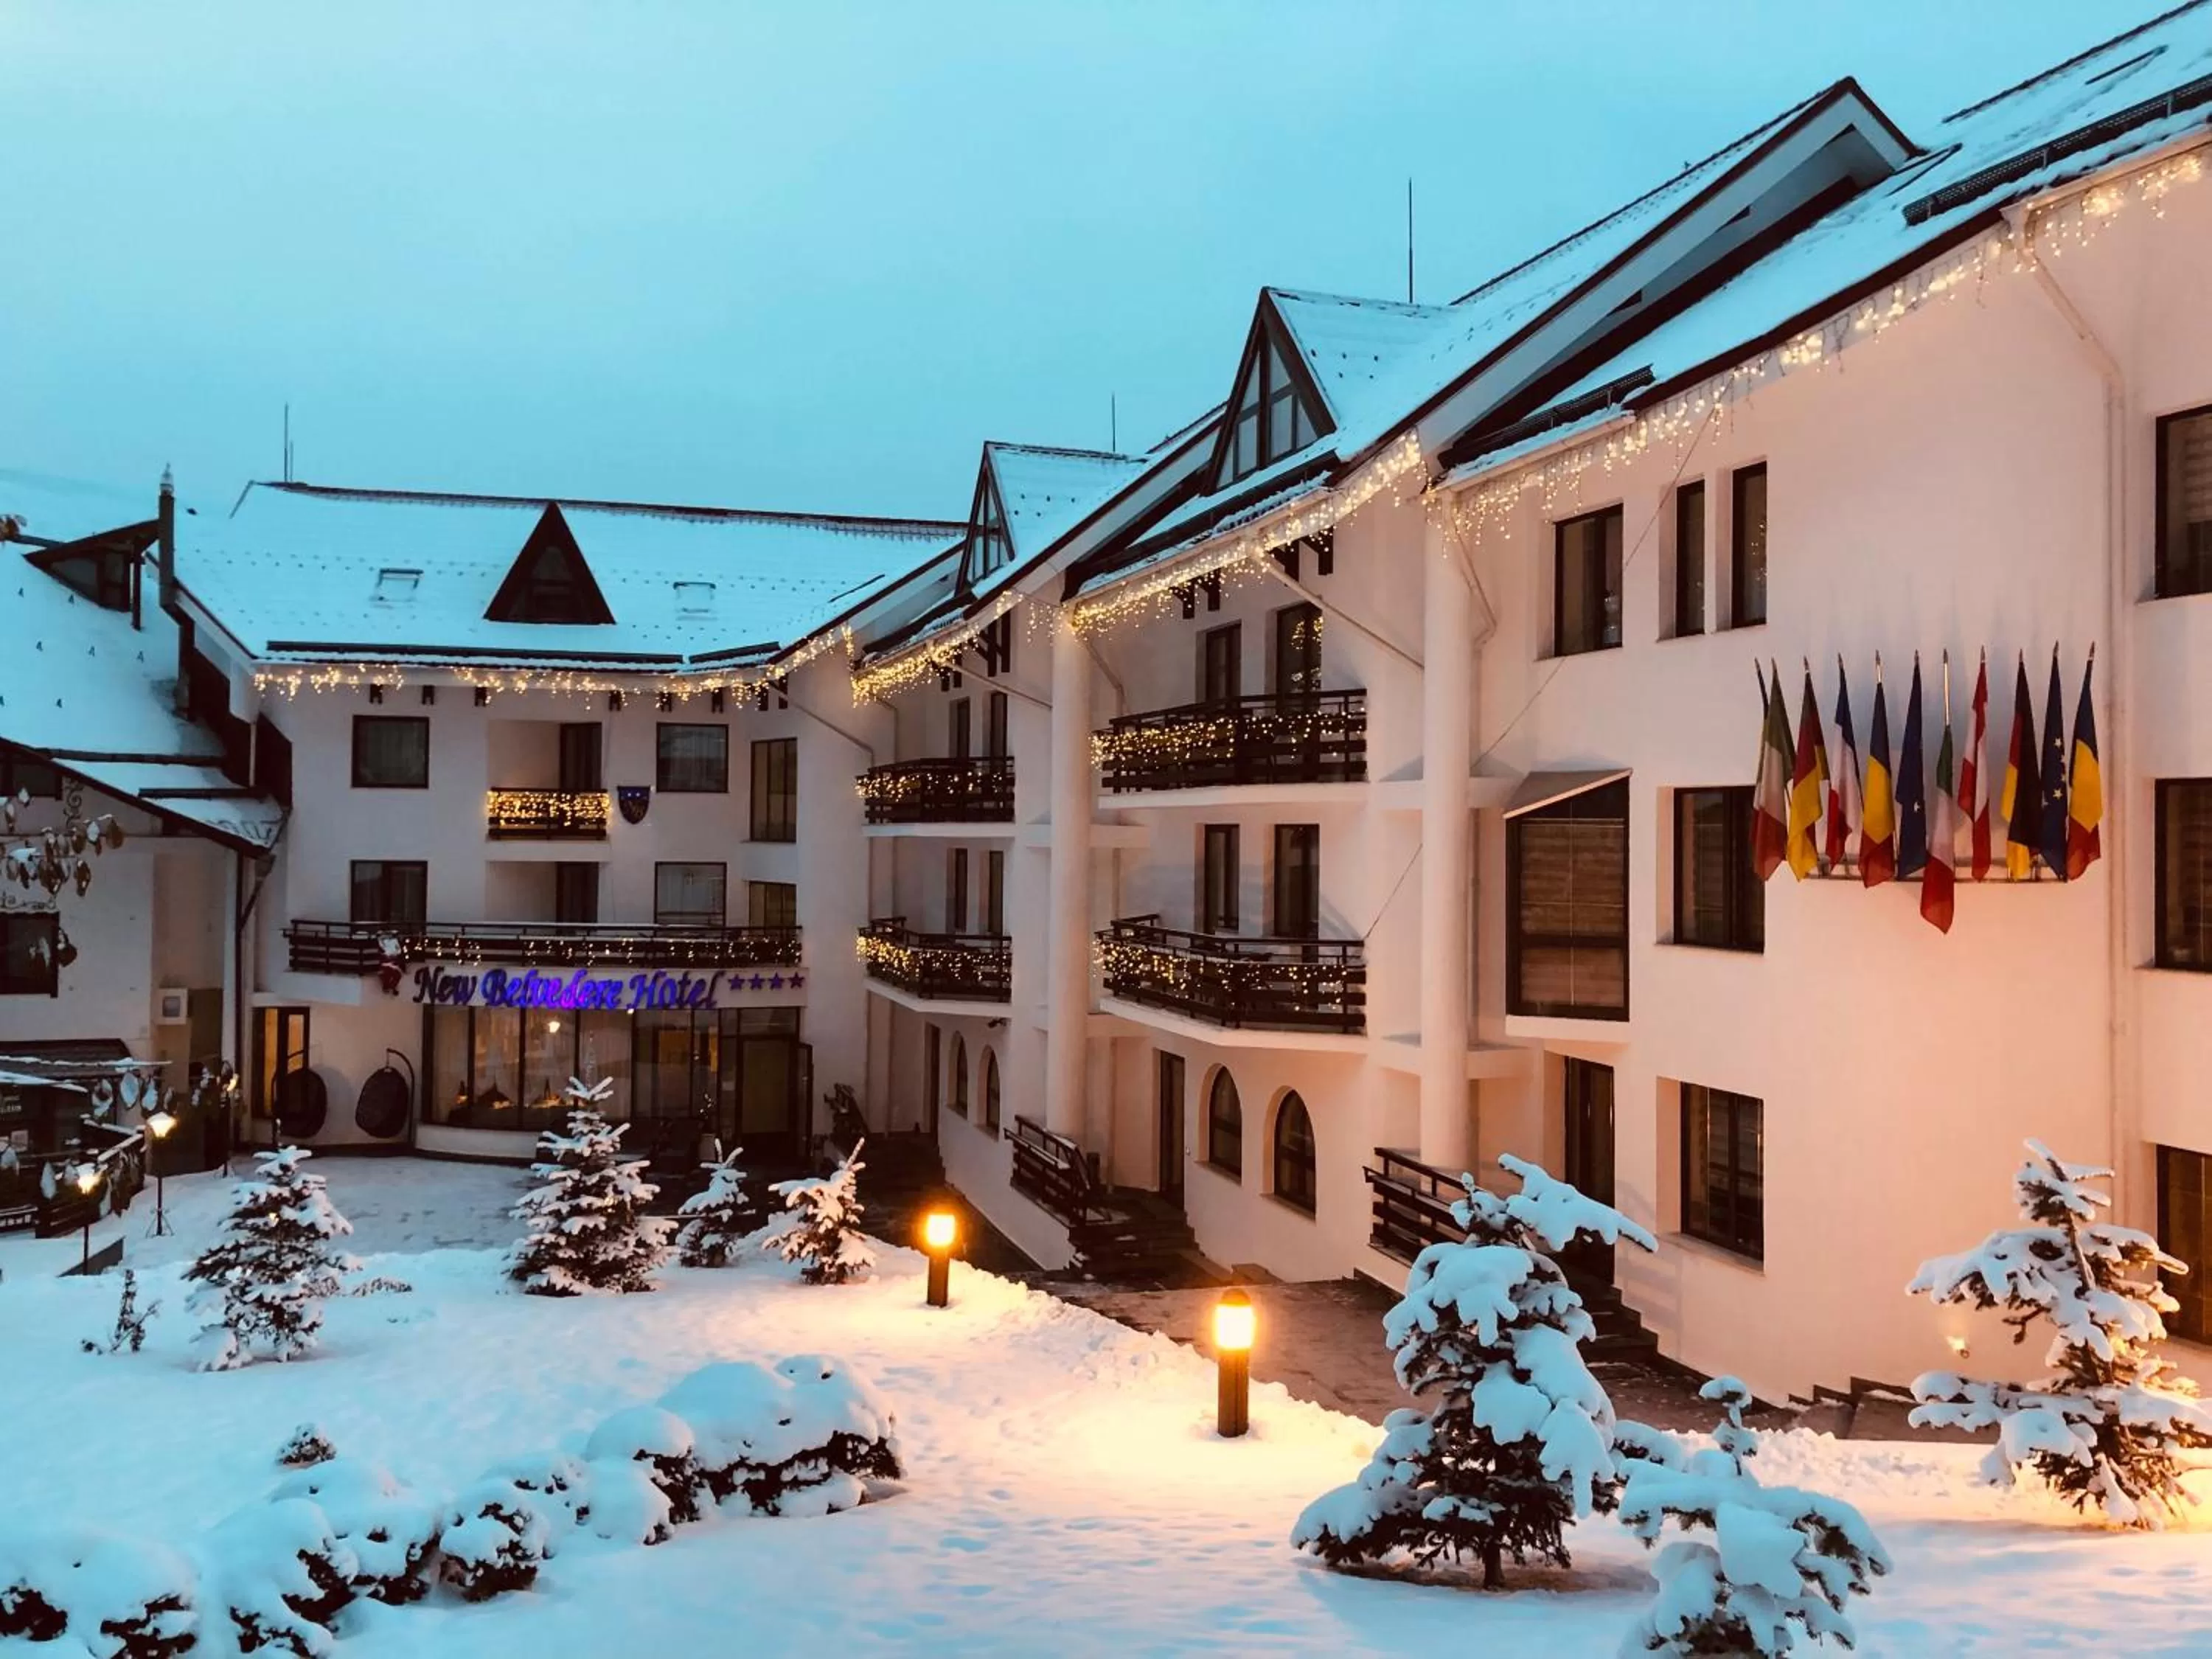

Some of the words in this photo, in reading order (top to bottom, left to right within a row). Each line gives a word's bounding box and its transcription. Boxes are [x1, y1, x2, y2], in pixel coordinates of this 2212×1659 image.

[413, 966, 478, 1004] New
[481, 968, 623, 1009] Belvedere
[626, 970, 726, 1009] Hotel
